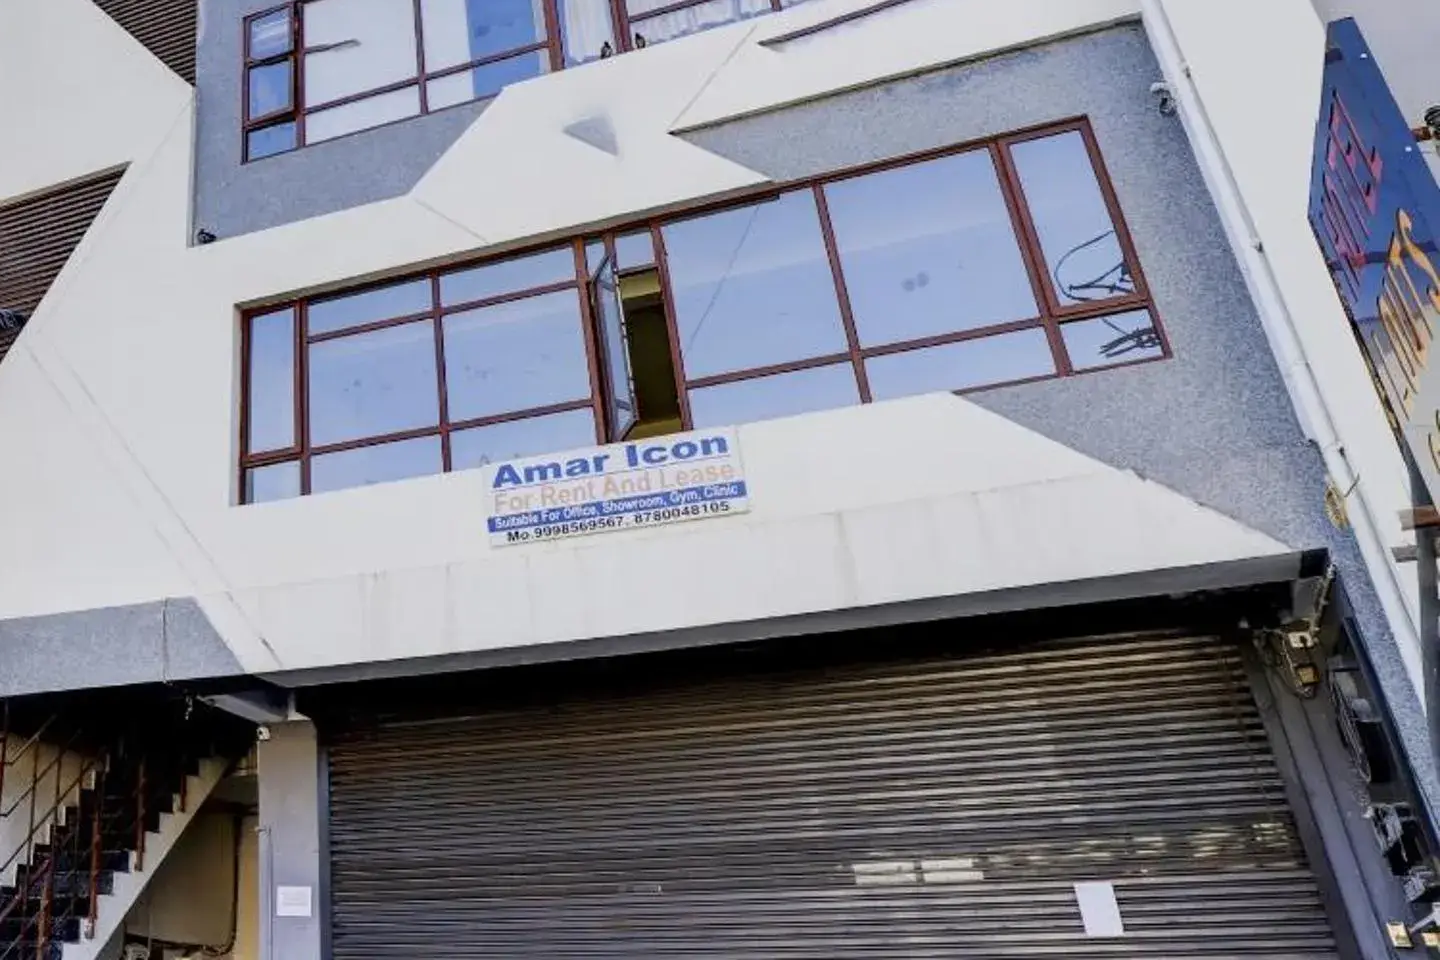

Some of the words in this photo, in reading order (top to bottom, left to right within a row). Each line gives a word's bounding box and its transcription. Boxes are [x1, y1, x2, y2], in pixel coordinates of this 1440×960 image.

[1318, 87, 1383, 303] HOTEL
[492, 453, 611, 488] Amar
[625, 435, 728, 467] Icon
[494, 492, 534, 514] For
[540, 481, 596, 508] Rent
[603, 470, 650, 499] And
[659, 463, 734, 489] Lease
[495, 513, 539, 528] Suitable
[541, 511, 561, 524] For
[703, 484, 738, 499] Clinic
